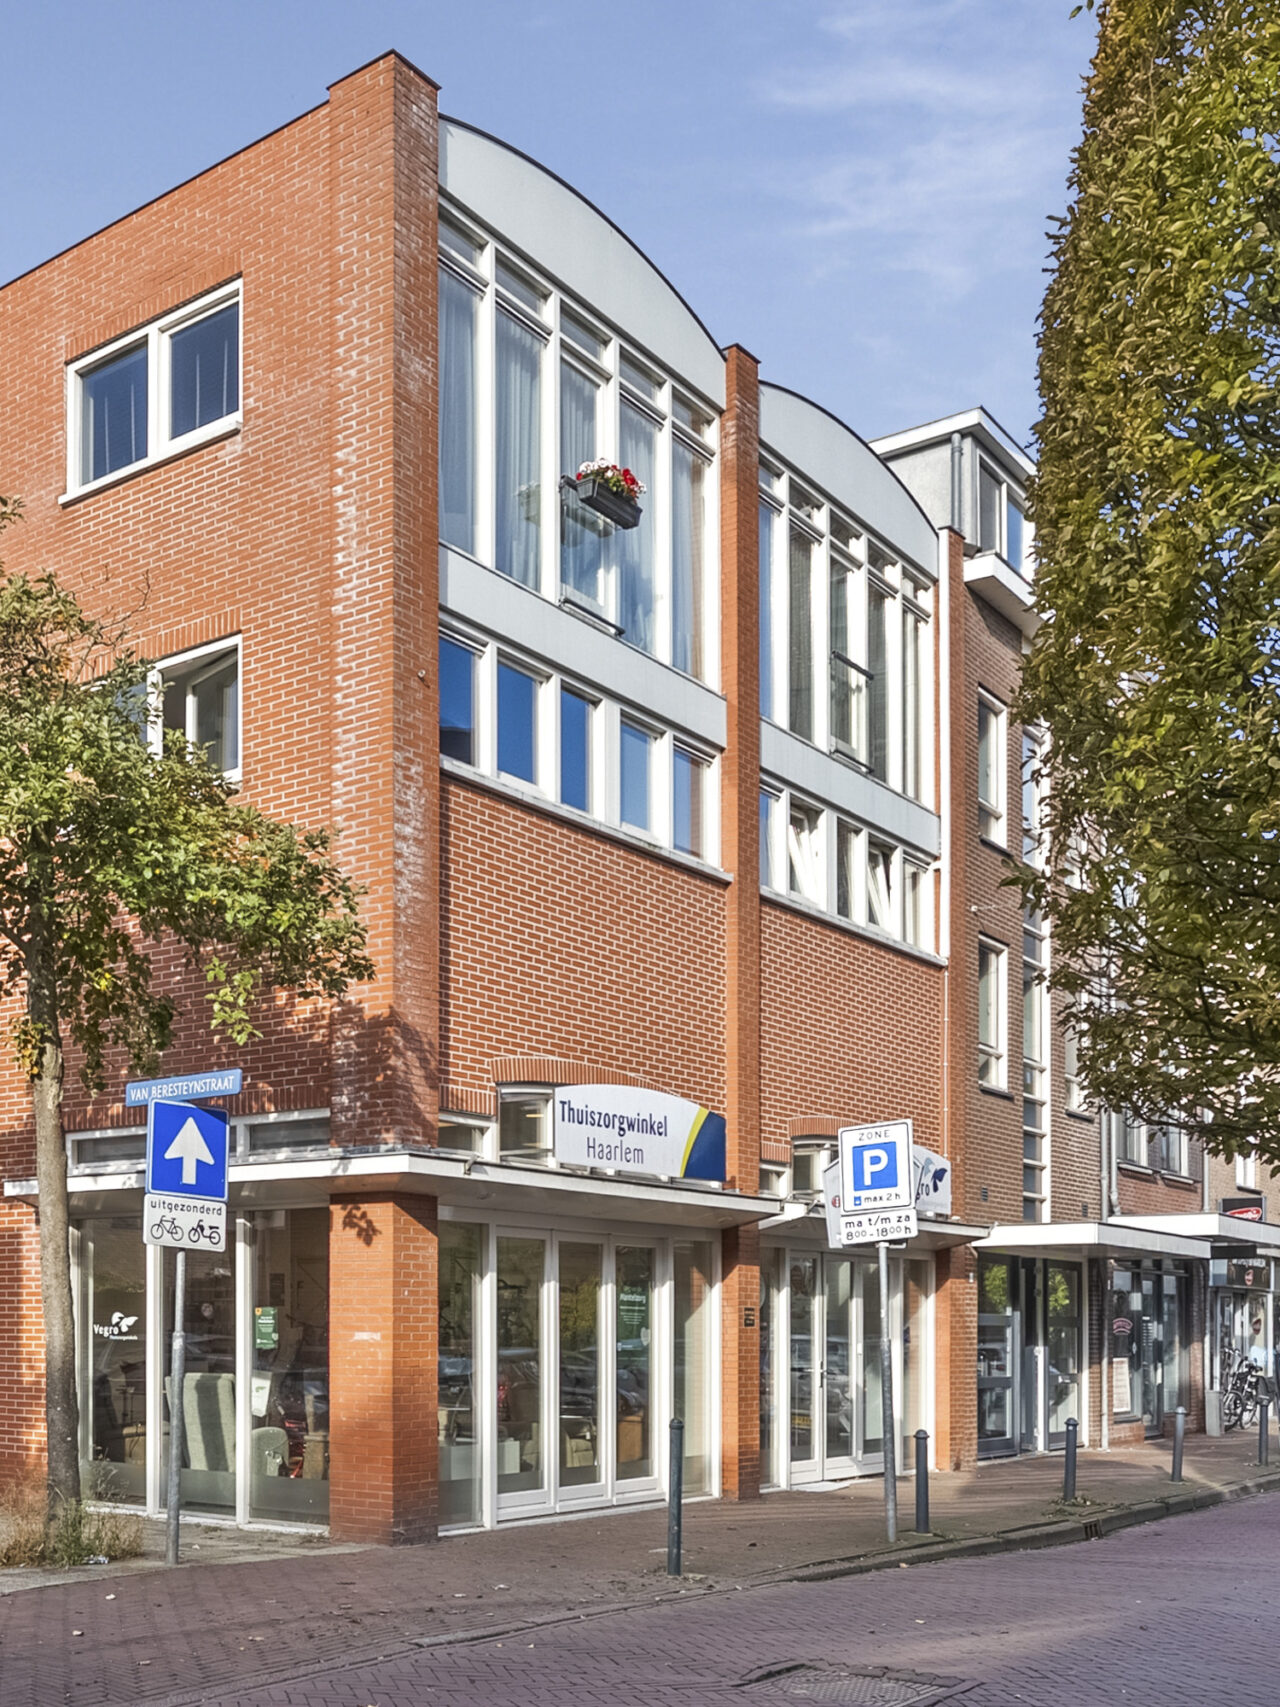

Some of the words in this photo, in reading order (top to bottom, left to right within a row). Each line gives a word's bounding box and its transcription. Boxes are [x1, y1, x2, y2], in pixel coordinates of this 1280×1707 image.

[130, 1087, 148, 1101] VAN
[151, 1075, 235, 1098] BERESTEYNSTRAAT
[559, 1100, 668, 1137] Thuiszorgwinkel
[859, 1130, 890, 1141] ZONE
[586, 1136, 644, 1165] Haarlem
[862, 1148, 889, 1187] P
[864, 1195, 883, 1204] max
[886, 1193, 893, 1201] 2
[150, 1199, 223, 1216] uitgezonderd
[845, 1220, 863, 1229] ma
[868, 1215, 891, 1226] t/m
[896, 1215, 910, 1223] za
[904, 1226, 912, 1235] h
[93, 1323, 119, 1338] Vegro
